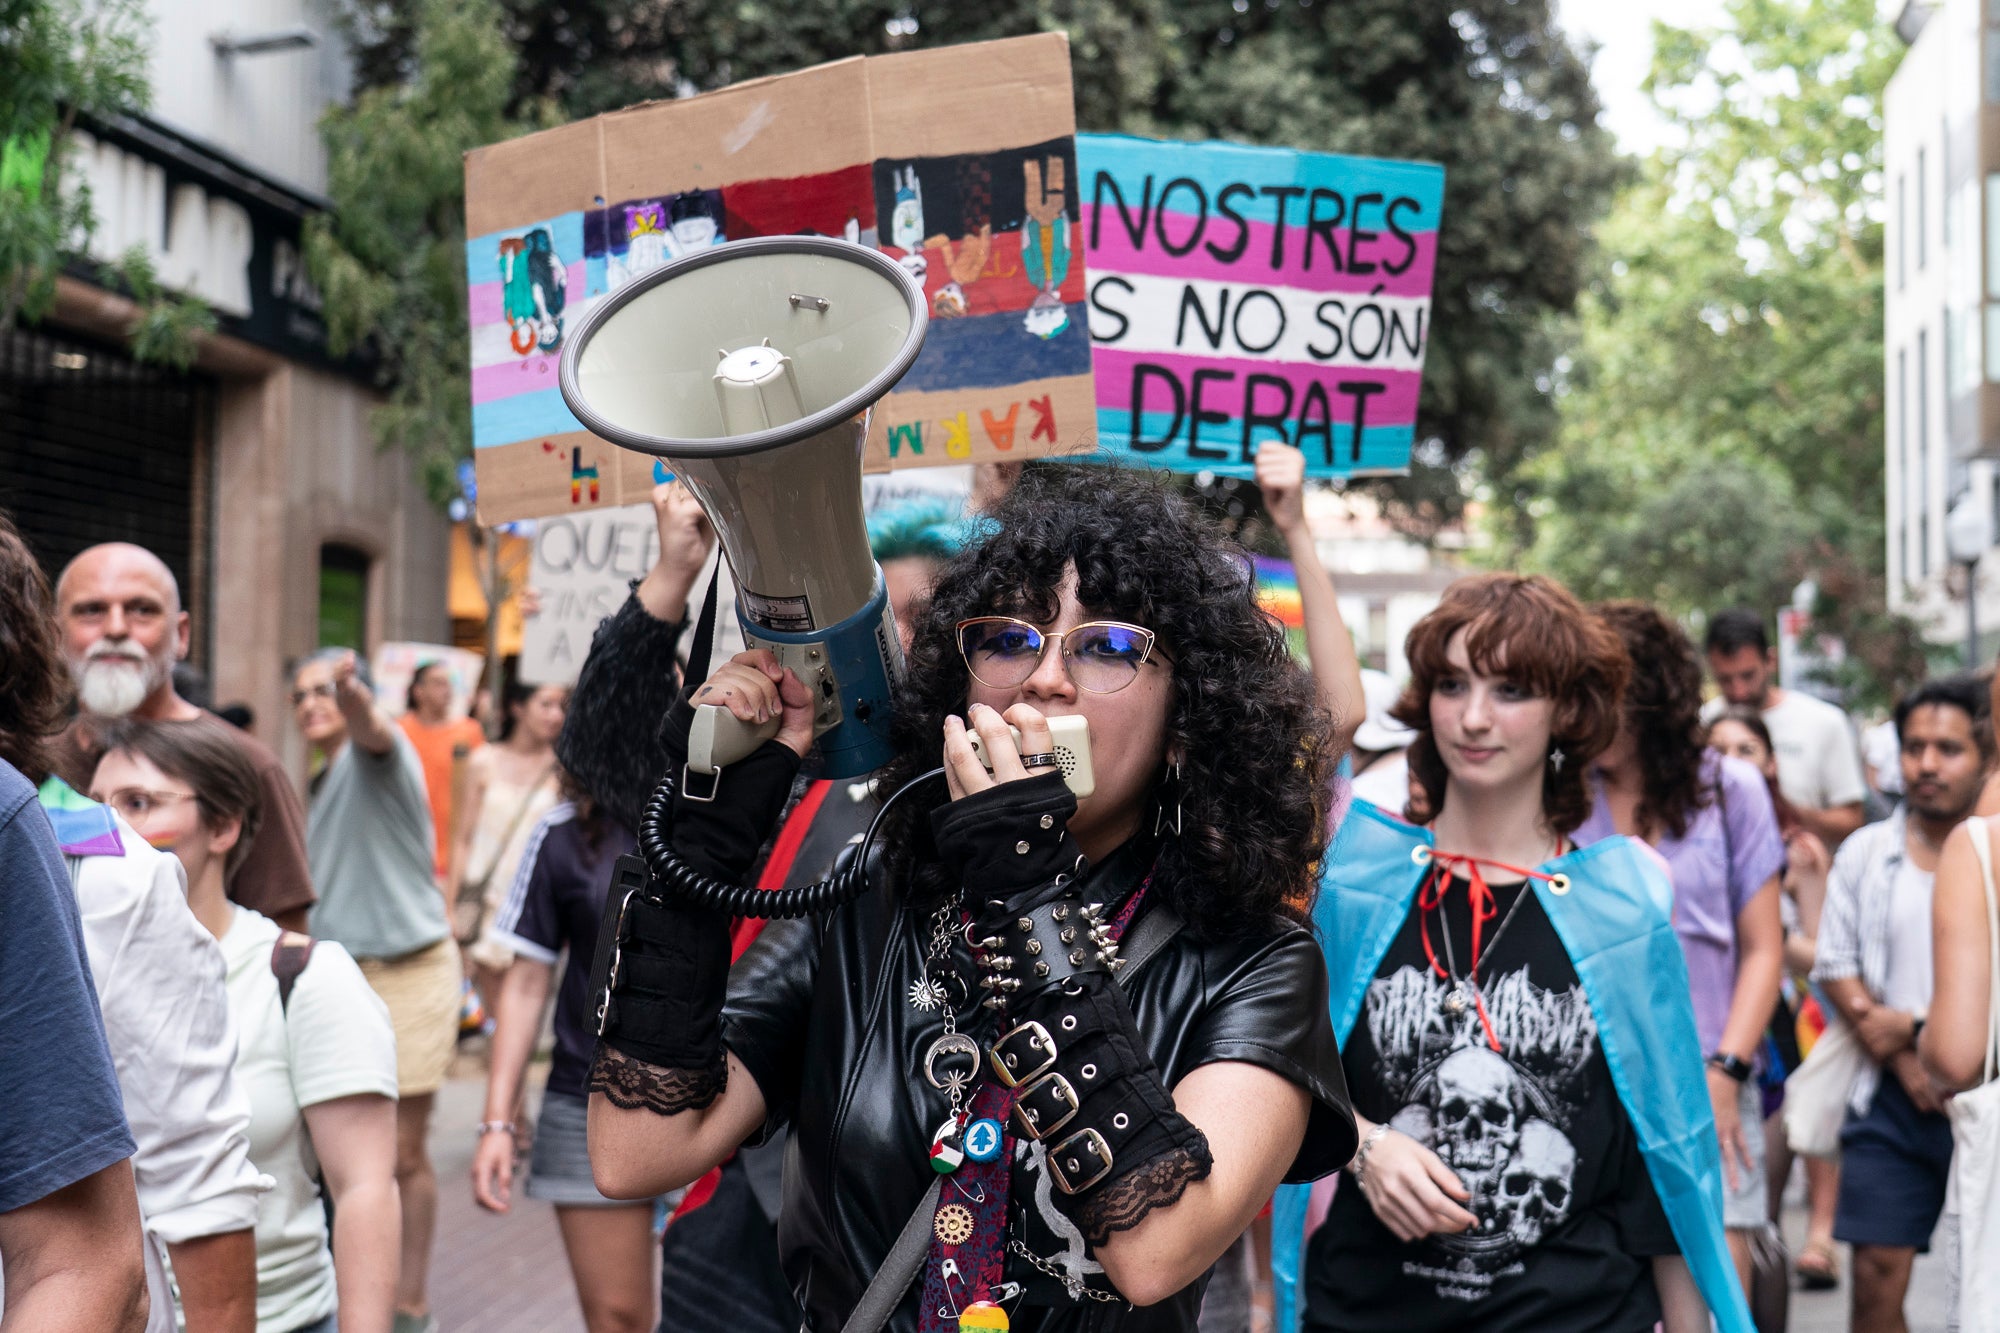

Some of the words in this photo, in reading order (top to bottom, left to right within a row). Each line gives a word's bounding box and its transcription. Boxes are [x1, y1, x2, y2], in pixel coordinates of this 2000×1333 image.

[1090, 169, 1422, 276] NOSTRES
[1175, 284, 1287, 353] NO
[1307, 283, 1424, 361] SÓN
[1129, 362, 1387, 466] DEBAT
